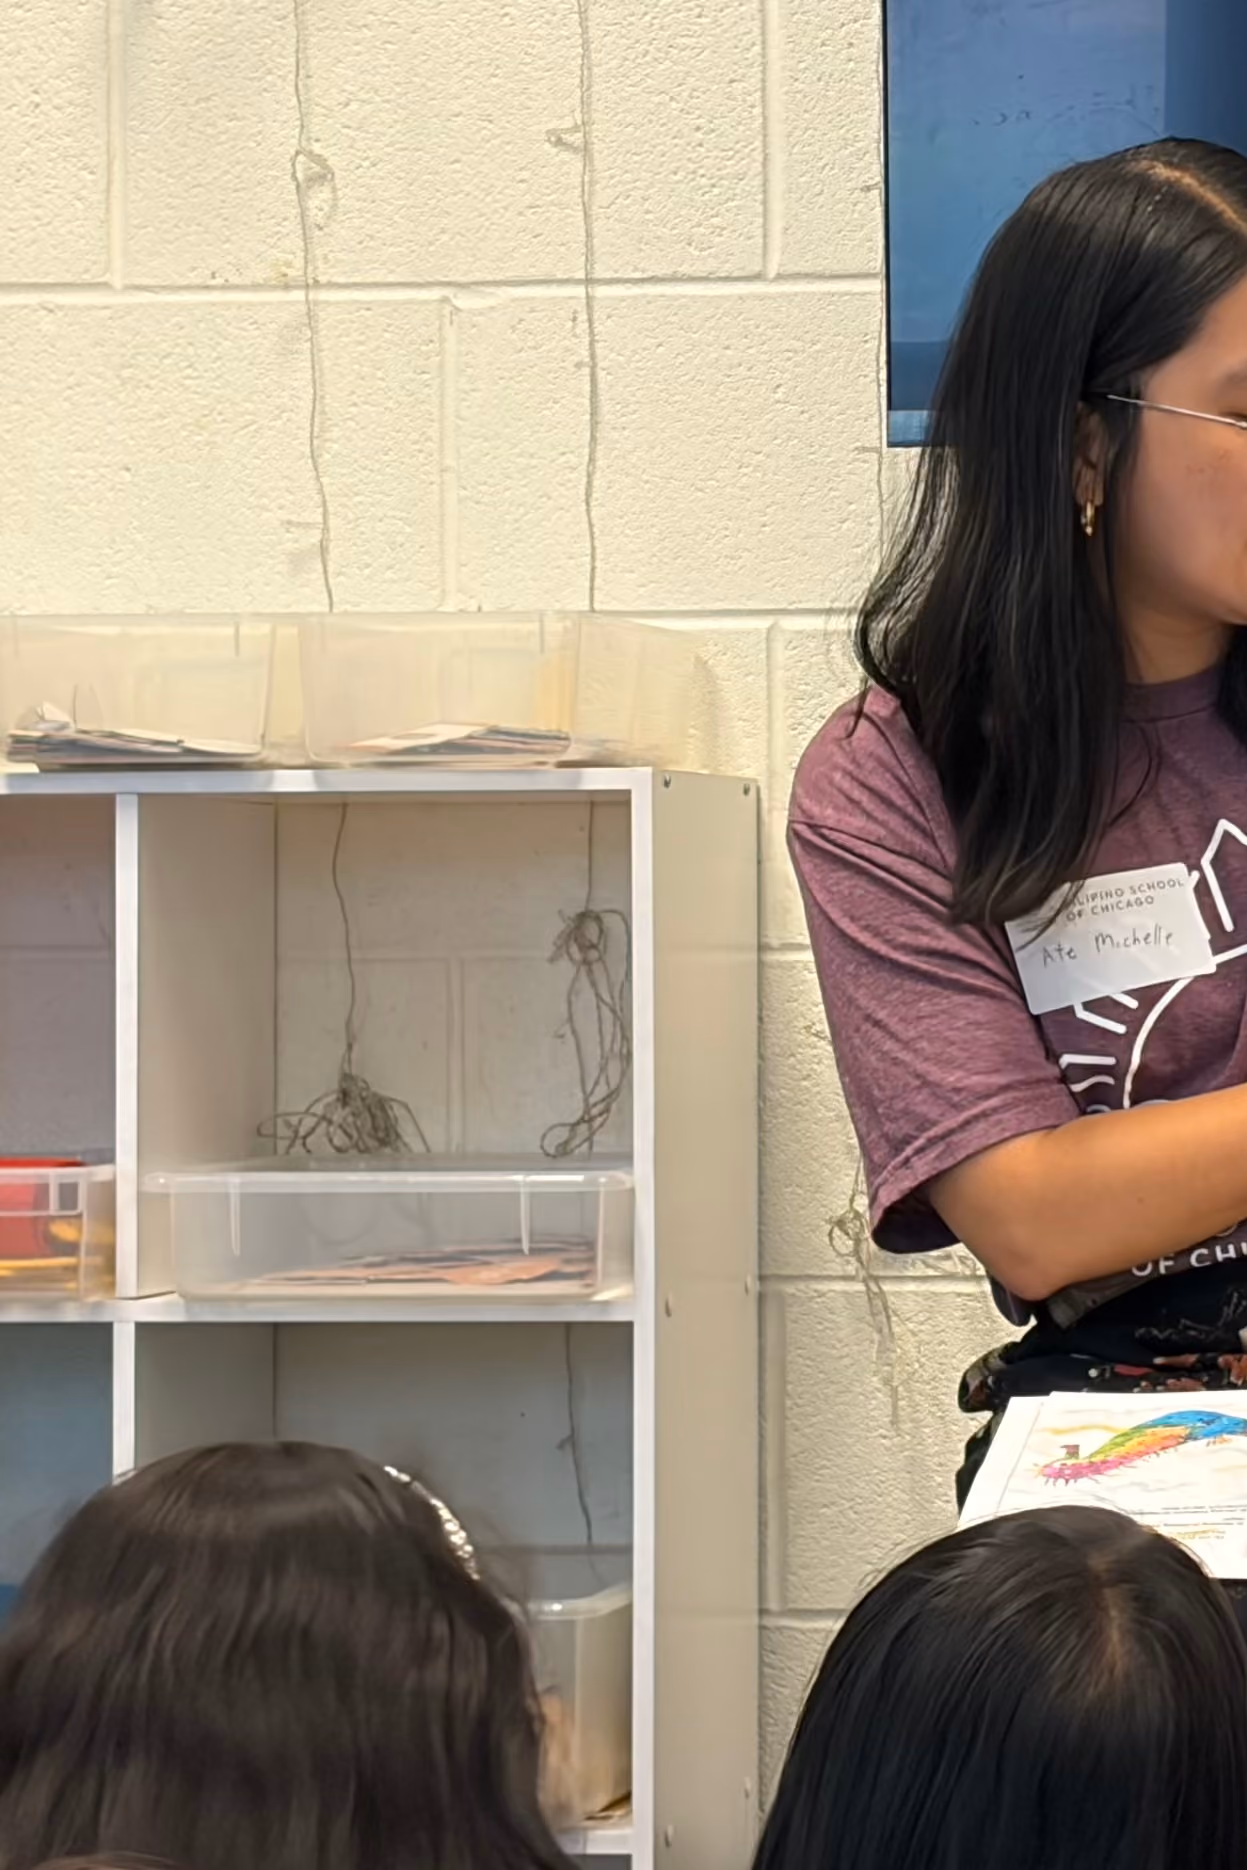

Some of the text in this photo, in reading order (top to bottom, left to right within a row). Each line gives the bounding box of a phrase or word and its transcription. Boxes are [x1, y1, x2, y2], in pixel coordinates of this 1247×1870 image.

[1129, 878, 1186, 896] SCHOOL
[1066, 895, 1155, 922] OF CHICAGO
[1041, 923, 1174, 970] Ate Michelle
